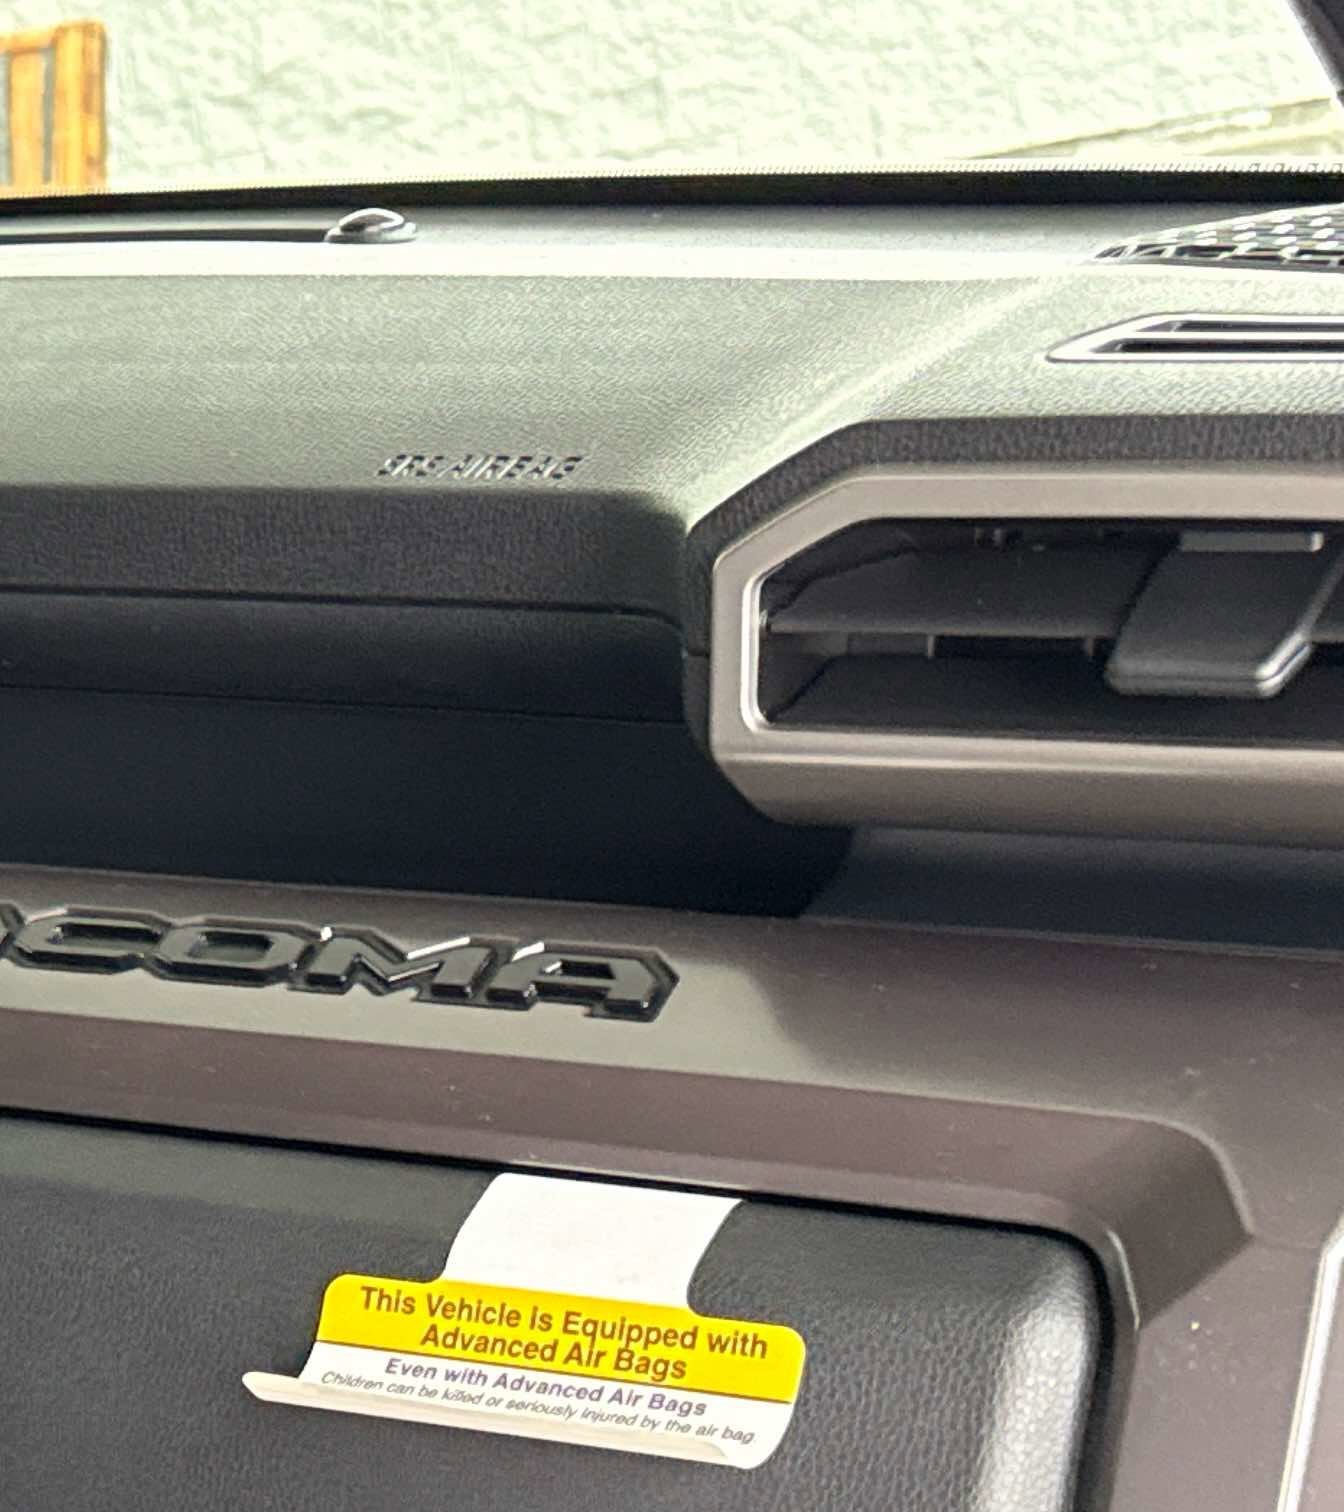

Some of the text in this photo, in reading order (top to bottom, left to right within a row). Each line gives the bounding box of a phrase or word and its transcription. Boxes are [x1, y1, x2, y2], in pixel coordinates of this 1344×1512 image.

[360, 1286, 768, 1359] This Vehicle is Equipped with
[420, 1324, 687, 1382] Advanced Air Bags
[321, 1370, 383, 1391] Children
[386, 1381, 416, 1396] can
[418, 1384, 438, 1399] be
[441, 1387, 485, 1406] killed
[486, 1396, 504, 1409] or
[506, 1397, 578, 1419] seriously
[581, 1407, 638, 1427] injured
[640, 1414, 662, 1431] by
[665, 1418, 691, 1434] the
[695, 1424, 719, 1438] air
[384, 1358, 707, 1417] Even with Advanced Air Bags
